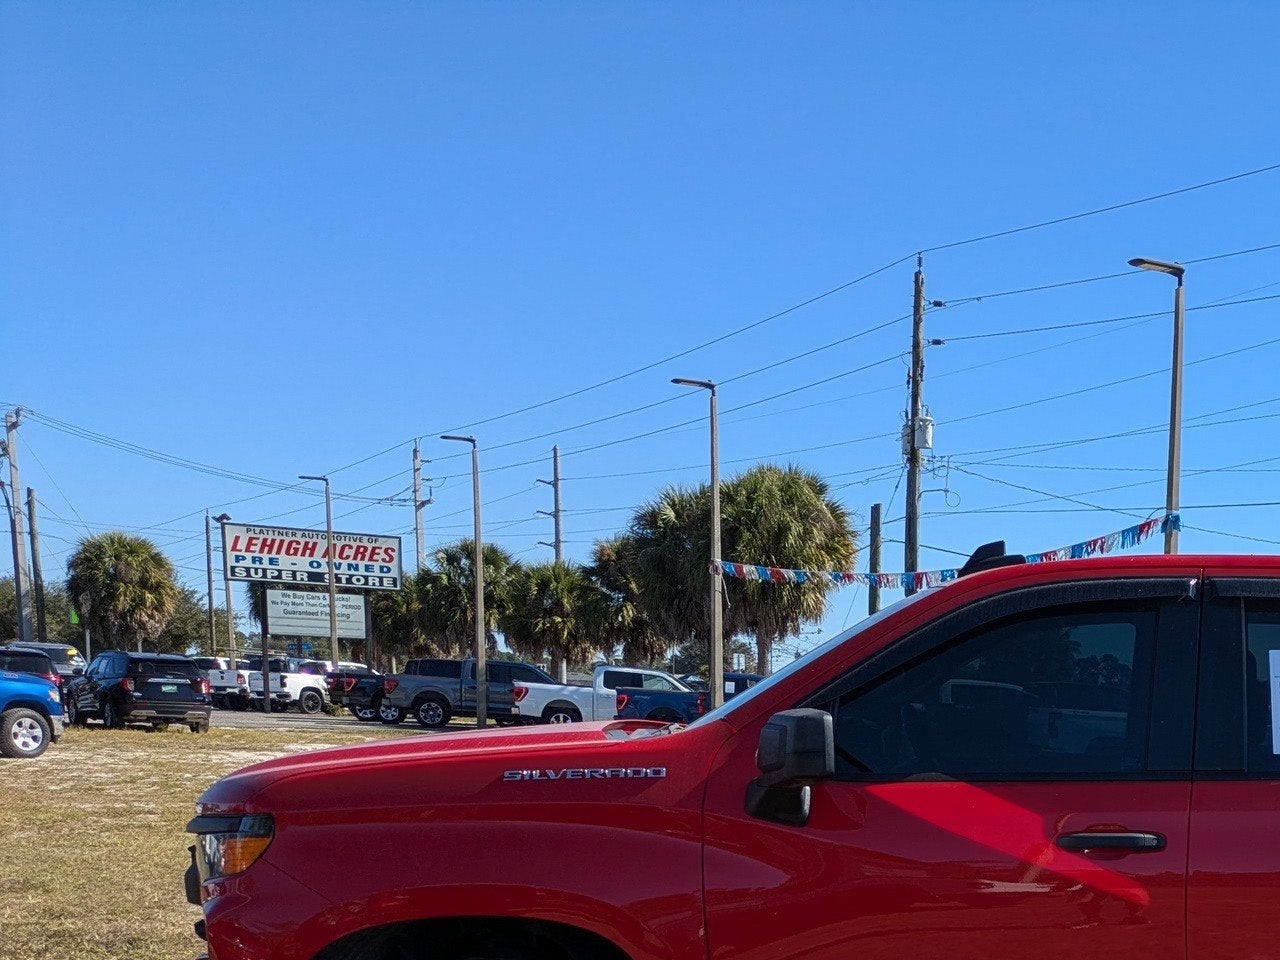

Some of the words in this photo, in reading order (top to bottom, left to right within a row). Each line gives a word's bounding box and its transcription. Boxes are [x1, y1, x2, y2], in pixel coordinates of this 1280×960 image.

[246, 527, 297, 538] PLATTNER
[231, 535, 318, 557] LEHIGH
[321, 543, 396, 563] ACRES
[234, 554, 280, 566] PRE
[234, 567, 309, 581] SUPER
[292, 592, 305, 600] Buy
[283, 608, 319, 617] Guaranteed
[320, 611, 351, 620] Fincing
[503, 767, 667, 781] SILVERADO
